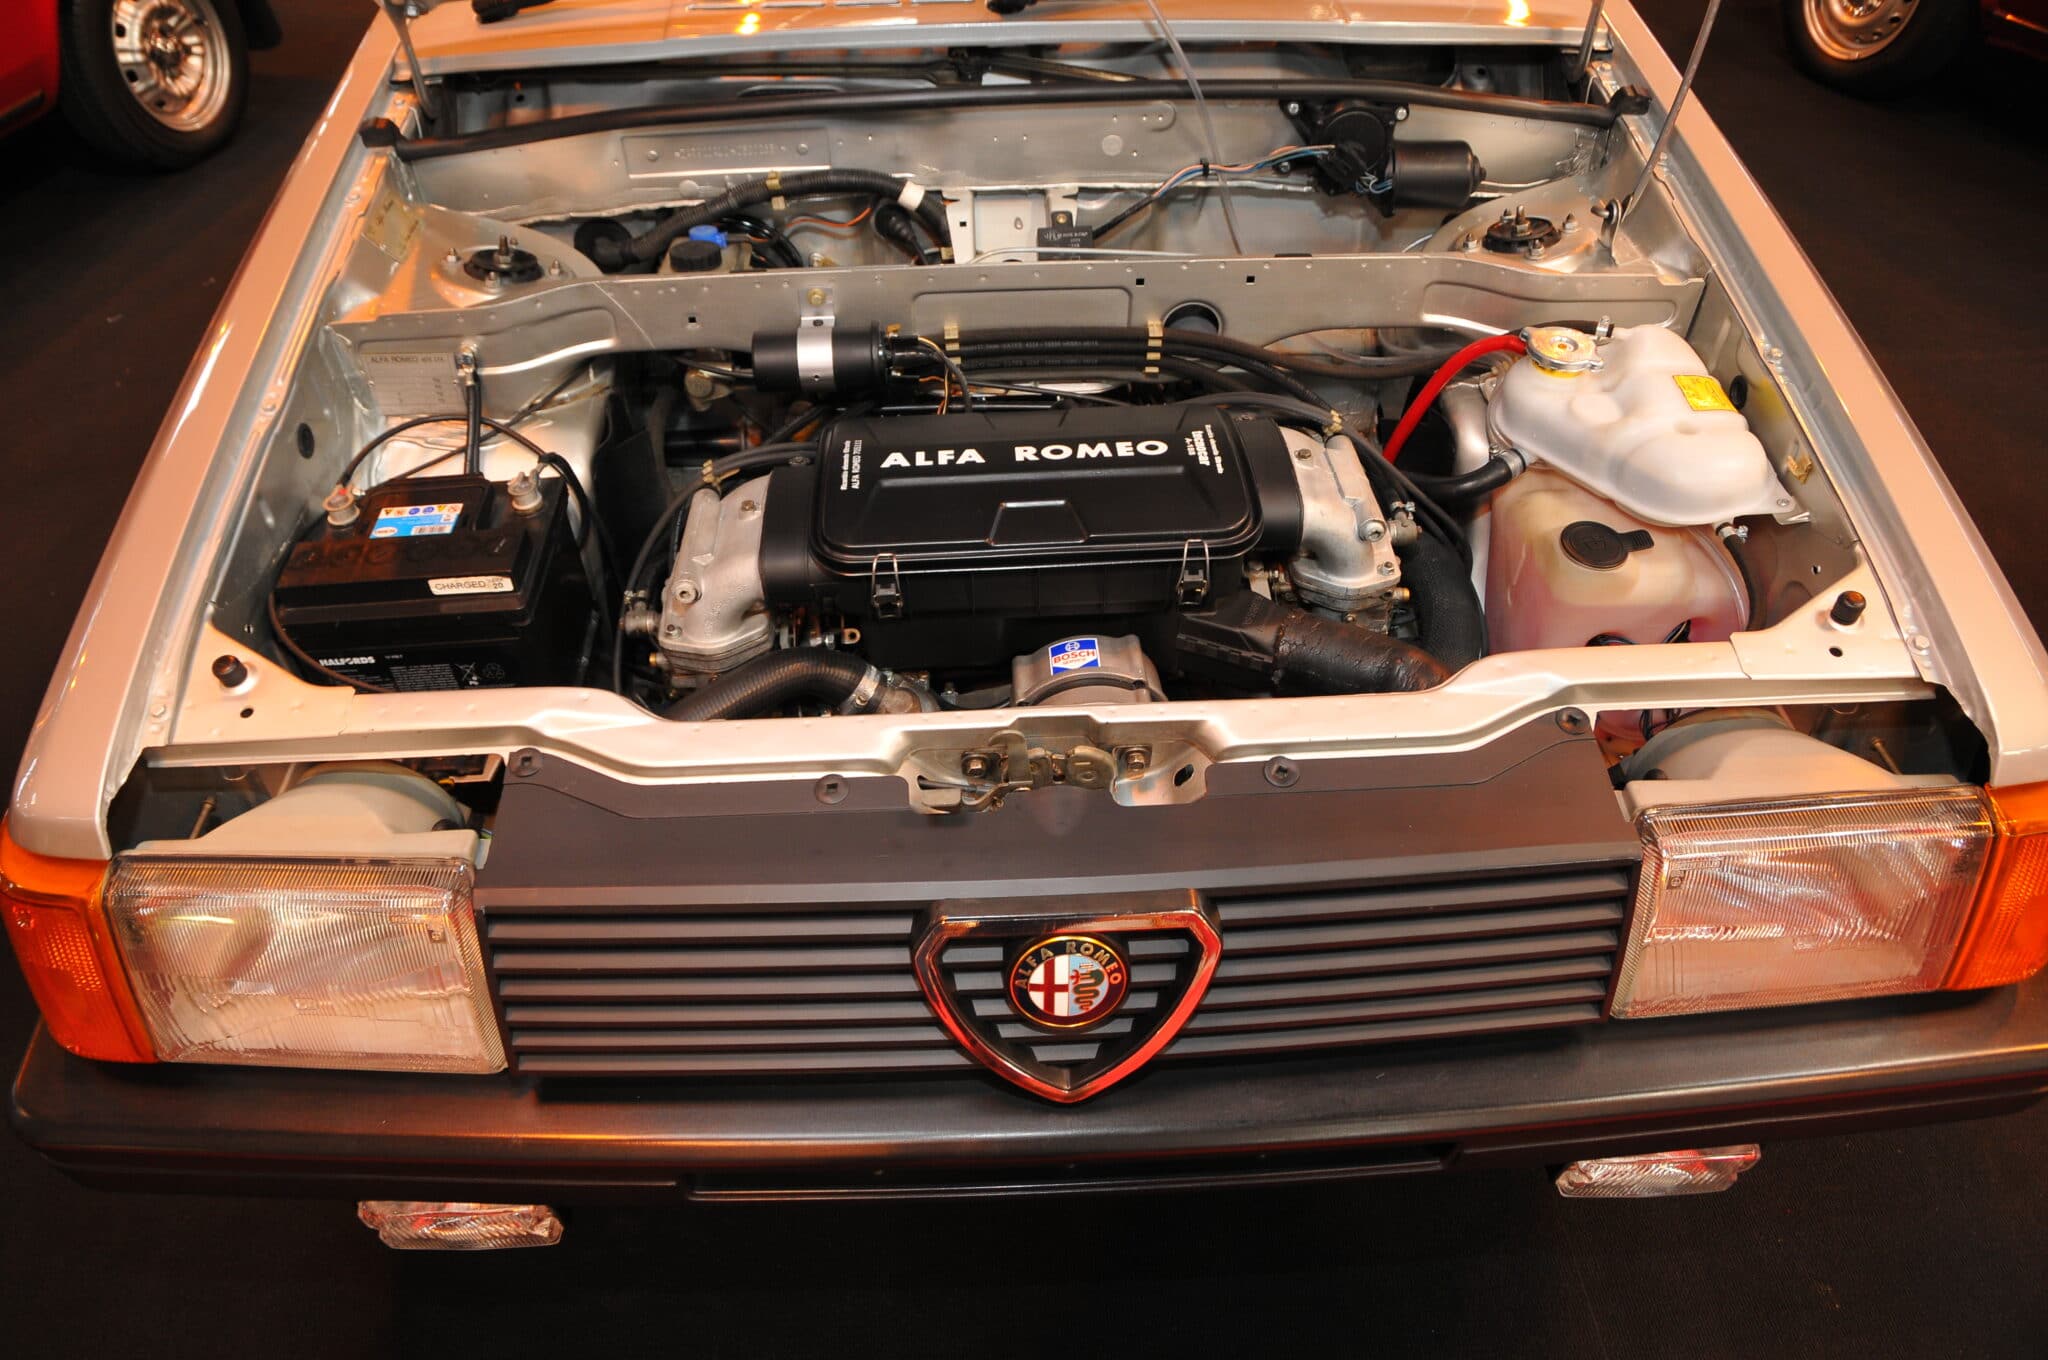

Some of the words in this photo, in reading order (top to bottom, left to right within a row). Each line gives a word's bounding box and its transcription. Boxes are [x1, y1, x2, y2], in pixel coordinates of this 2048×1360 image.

[880, 448, 986, 468] ALFA
[1014, 440, 1169, 462] ROMEO
[434, 580, 486, 590] CHARGED
[319, 656, 376, 667] HALFORDS
[1054, 650, 1095, 664] BOSCH
[1014, 947, 1054, 989] ALFA
[1066, 941, 1122, 985] ROMEO
